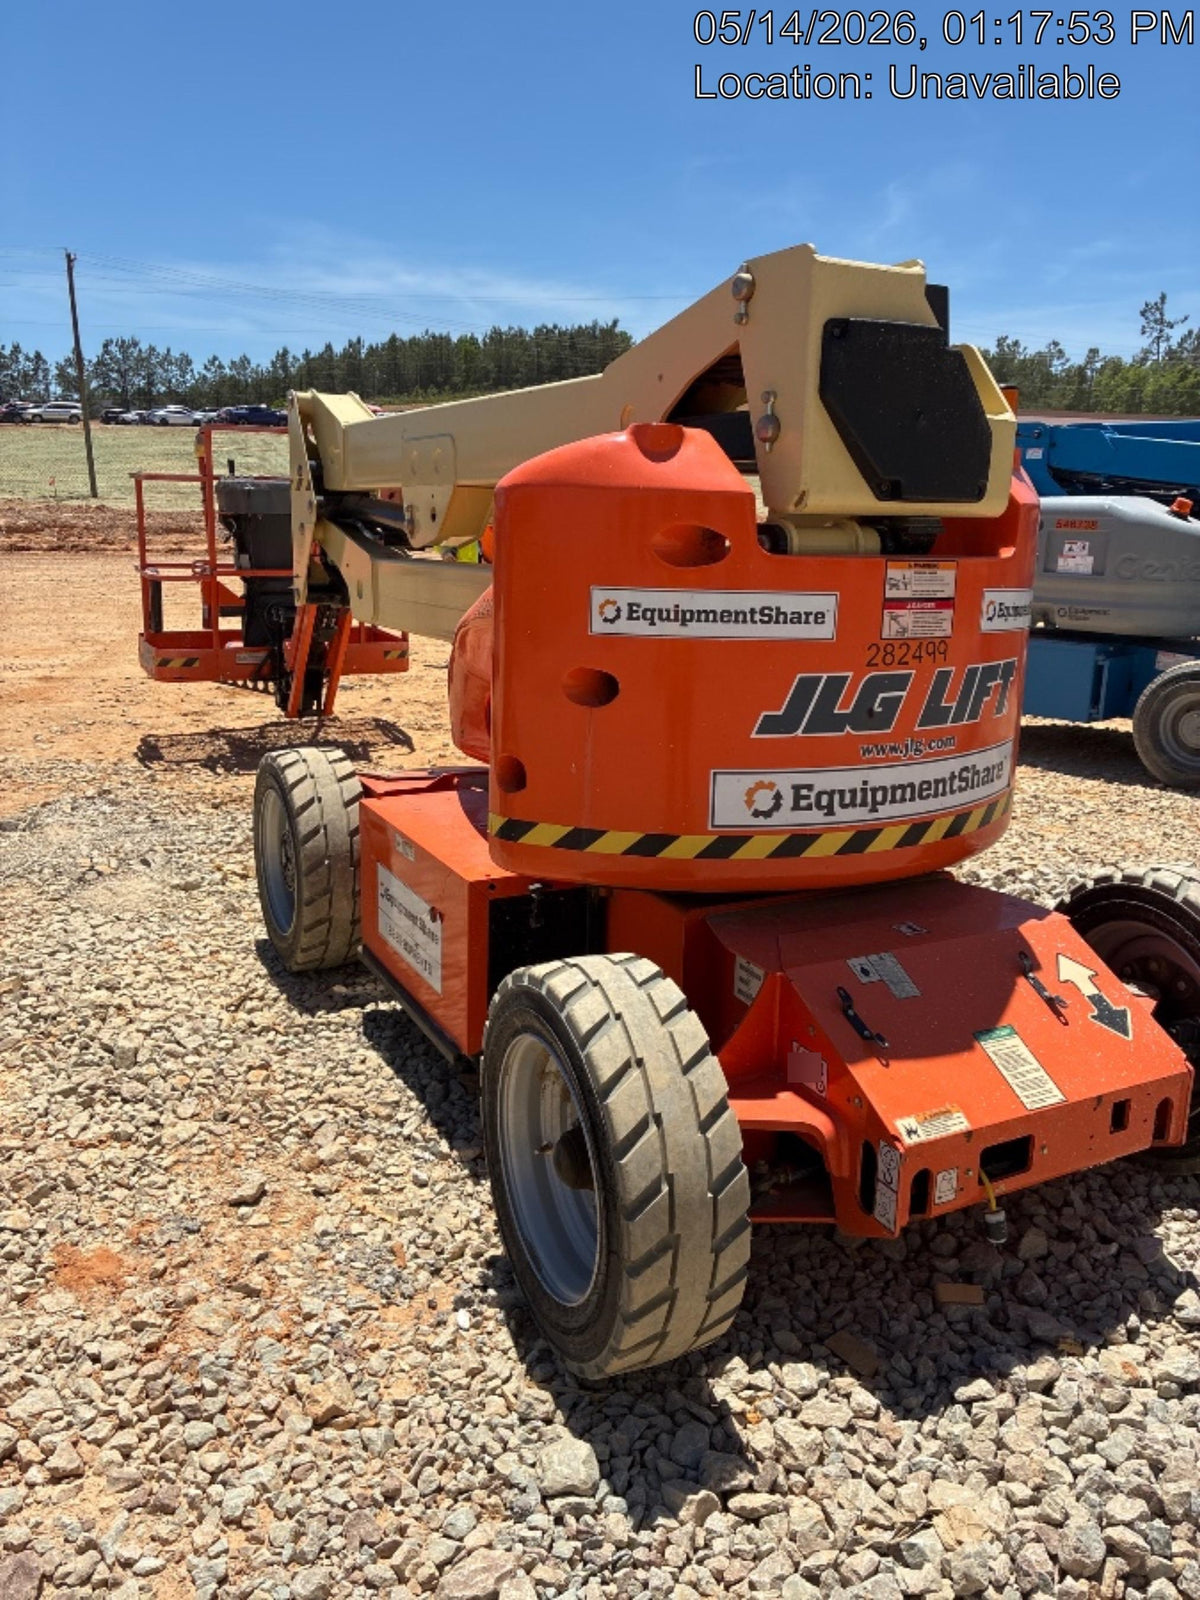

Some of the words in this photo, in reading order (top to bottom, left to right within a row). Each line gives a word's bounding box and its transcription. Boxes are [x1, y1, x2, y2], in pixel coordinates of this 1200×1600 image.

[626, 602, 827, 627] EquipmentShare
[866, 640, 949, 667] 282499
[751, 670, 916, 738] JLG
[915, 658, 1017, 730] LIFT
[860, 736, 956, 759] www.jlg.com
[790, 765, 1004, 816] EquipmentShare
